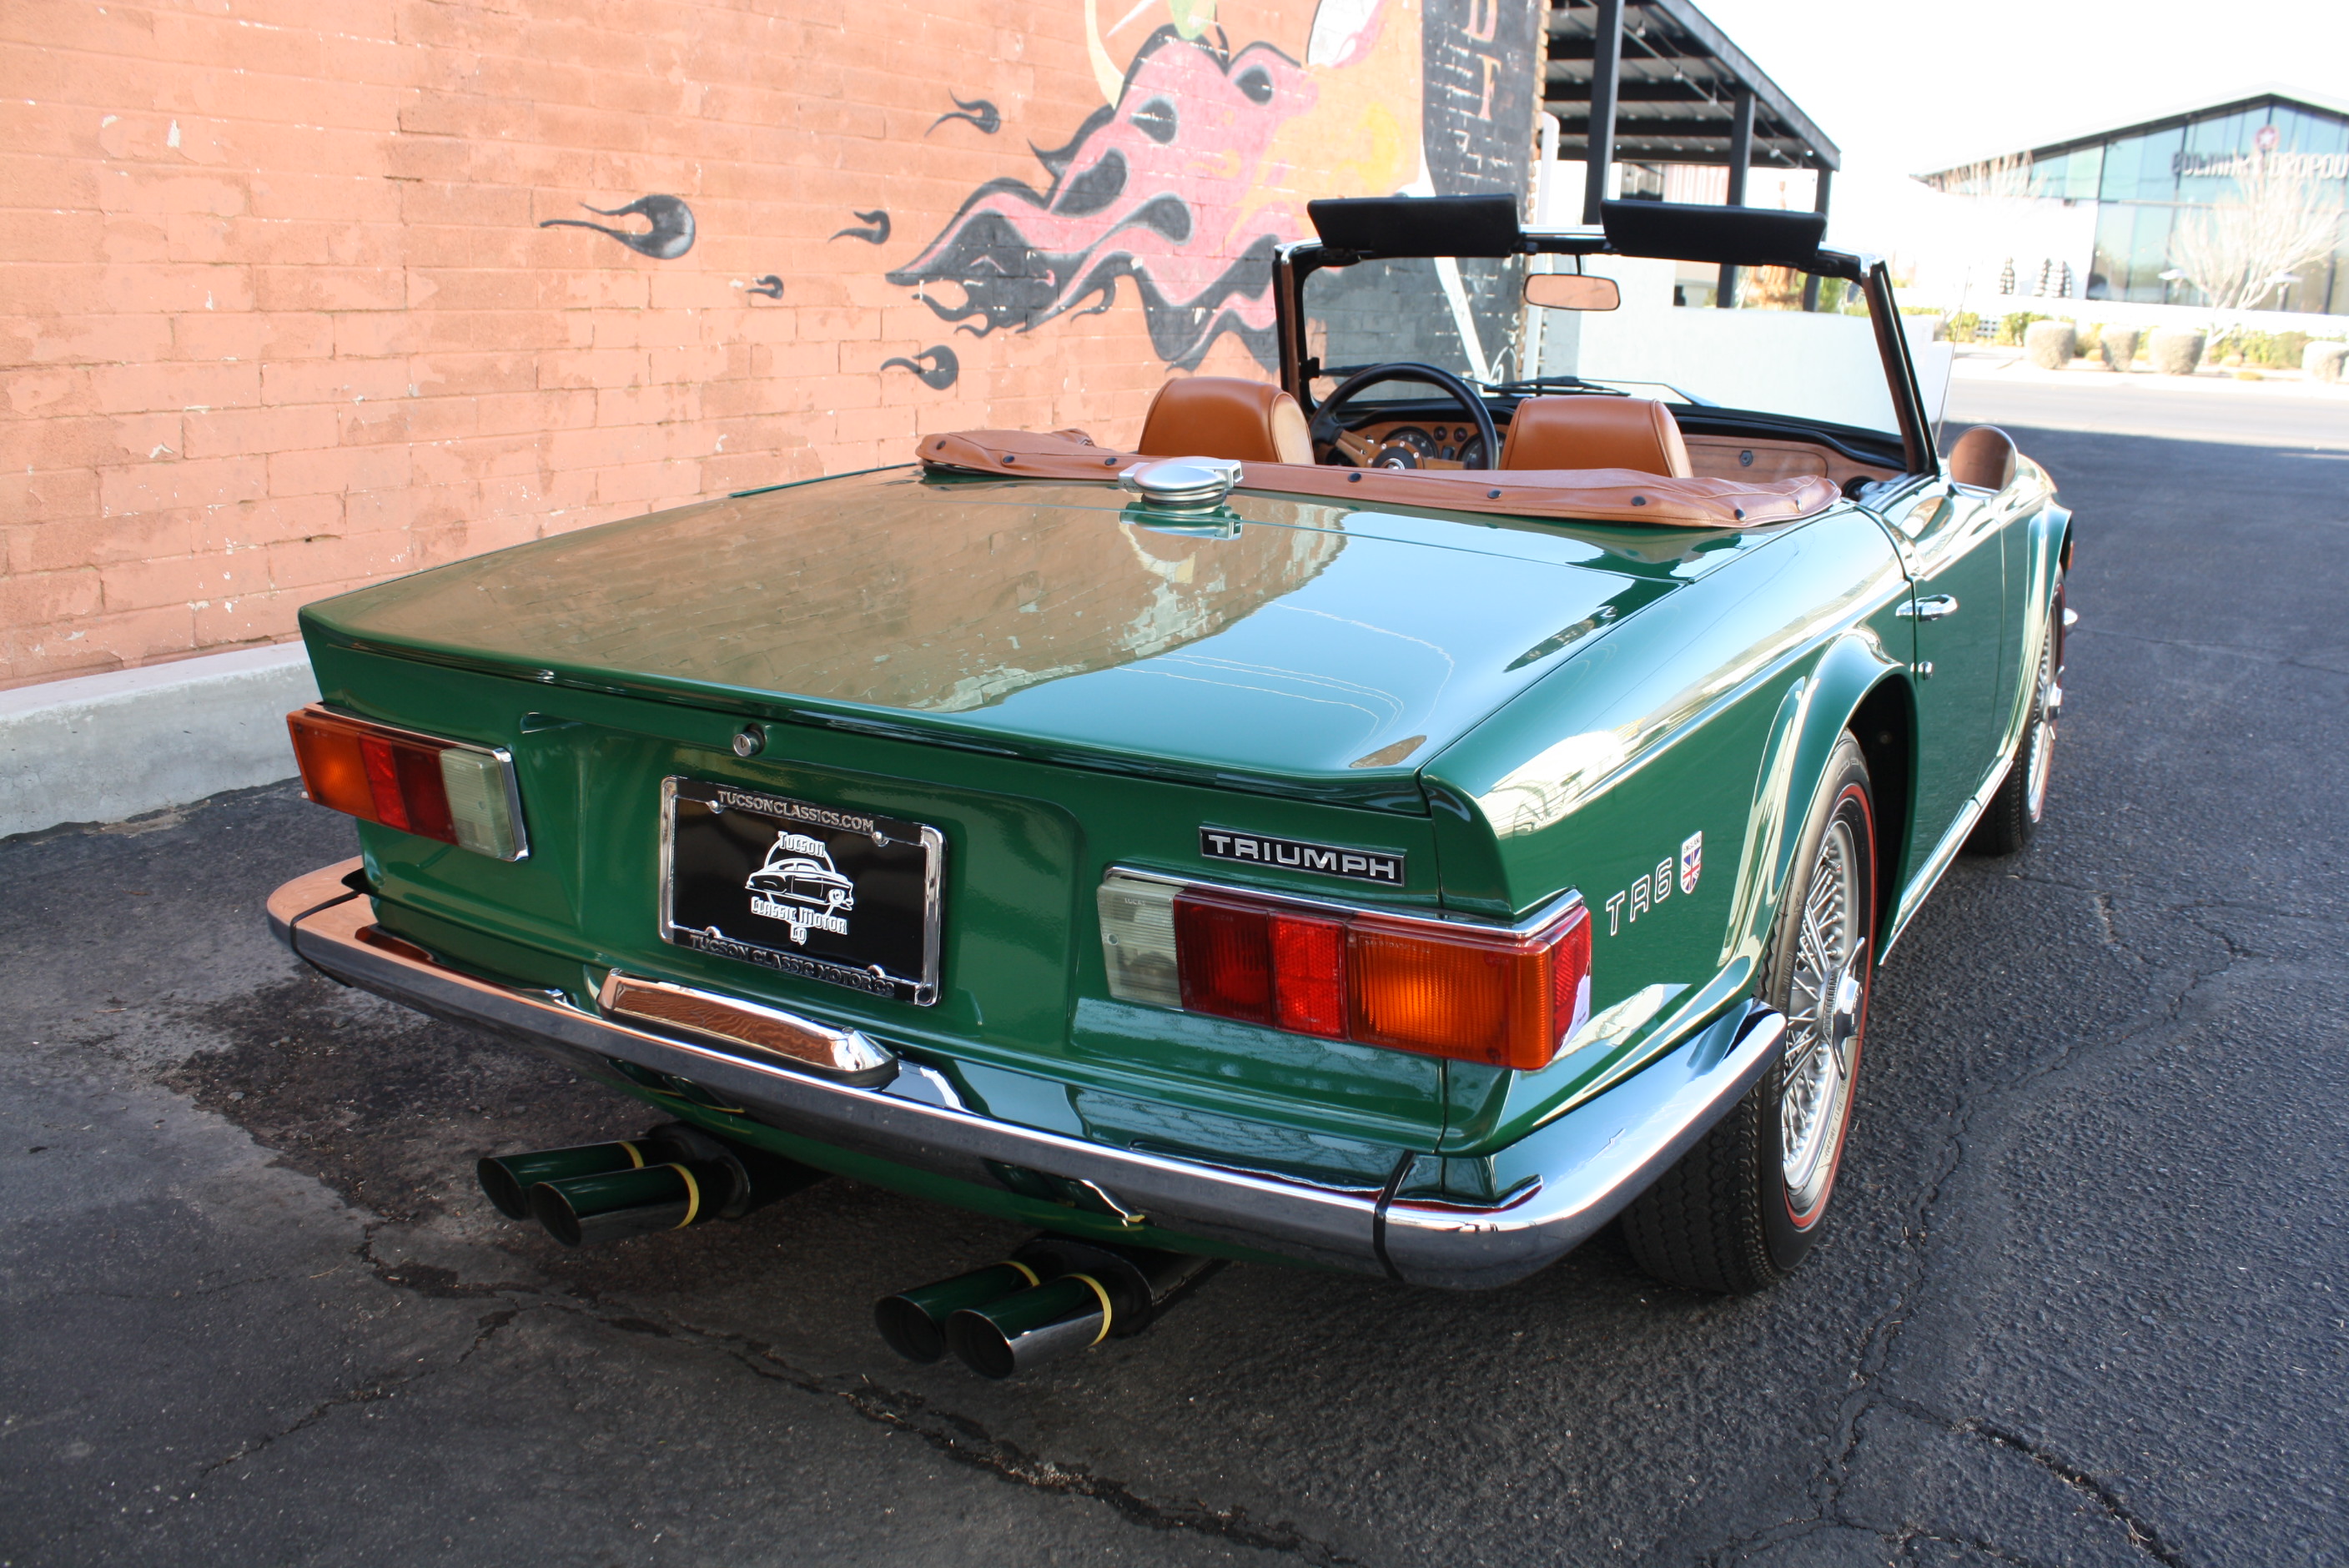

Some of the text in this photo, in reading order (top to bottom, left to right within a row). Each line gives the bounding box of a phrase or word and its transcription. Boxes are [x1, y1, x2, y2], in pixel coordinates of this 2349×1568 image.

[717, 791, 874, 832] TUCSONCLASSICS.COM
[1208, 834, 1395, 880] TRIUMPH
[1606, 857, 1672, 937] TR6
[690, 933, 749, 962] TUCSON
[752, 950, 814, 976] CLASSIC
[817, 964, 873, 991] MOTOR
